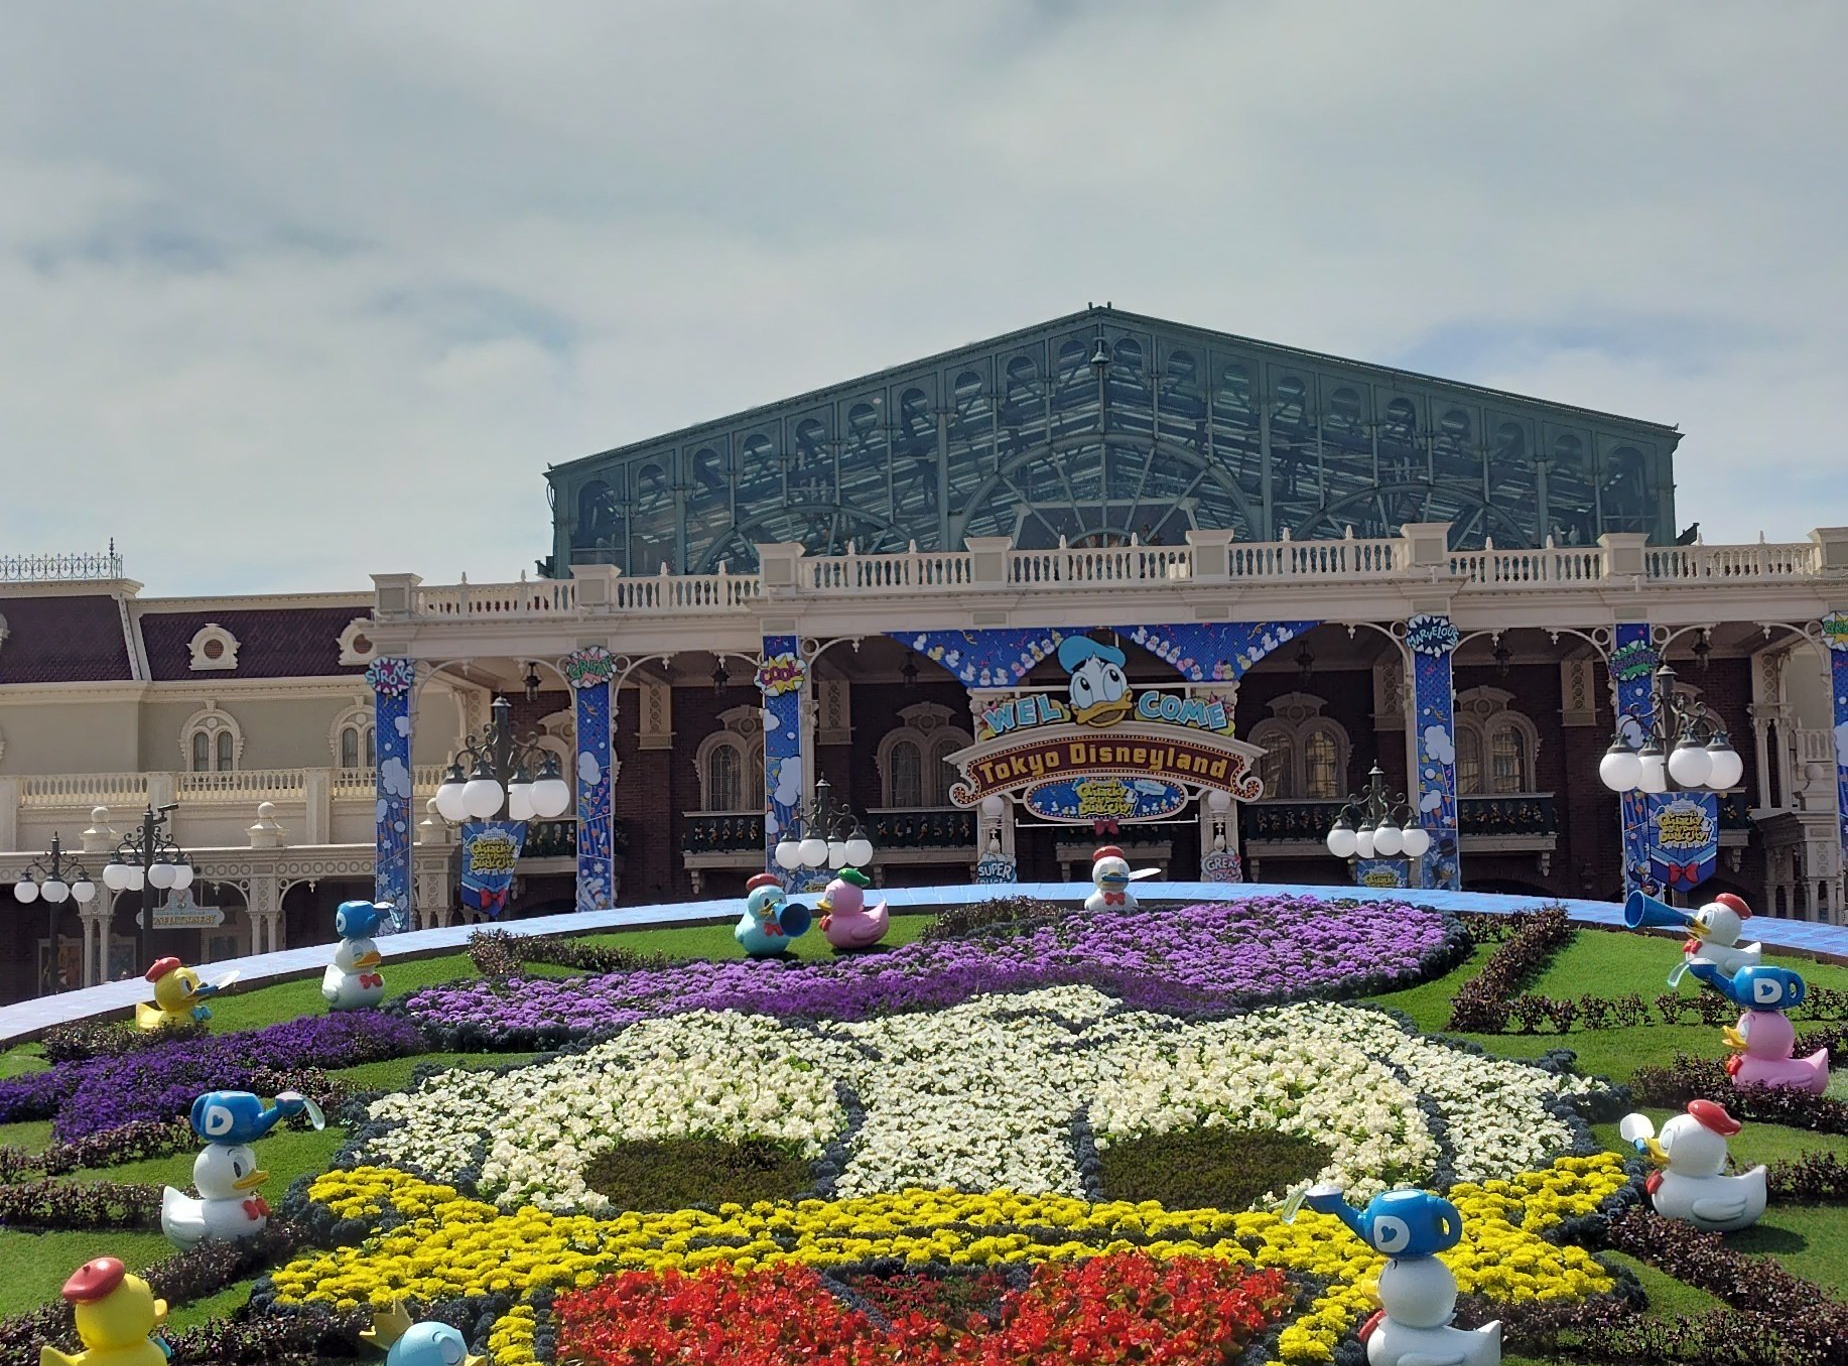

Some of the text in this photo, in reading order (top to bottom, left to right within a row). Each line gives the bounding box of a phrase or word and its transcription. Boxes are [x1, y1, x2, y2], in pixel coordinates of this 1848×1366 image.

[1406, 625, 1459, 647] MARVELOUS
[365, 665, 413, 685] STRONG
[760, 660, 803, 686] COOL
[978, 743, 1228, 784] Tokyo Disneyland
[978, 862, 1012, 879] SUPER
[1206, 857, 1239, 871] GREAT
